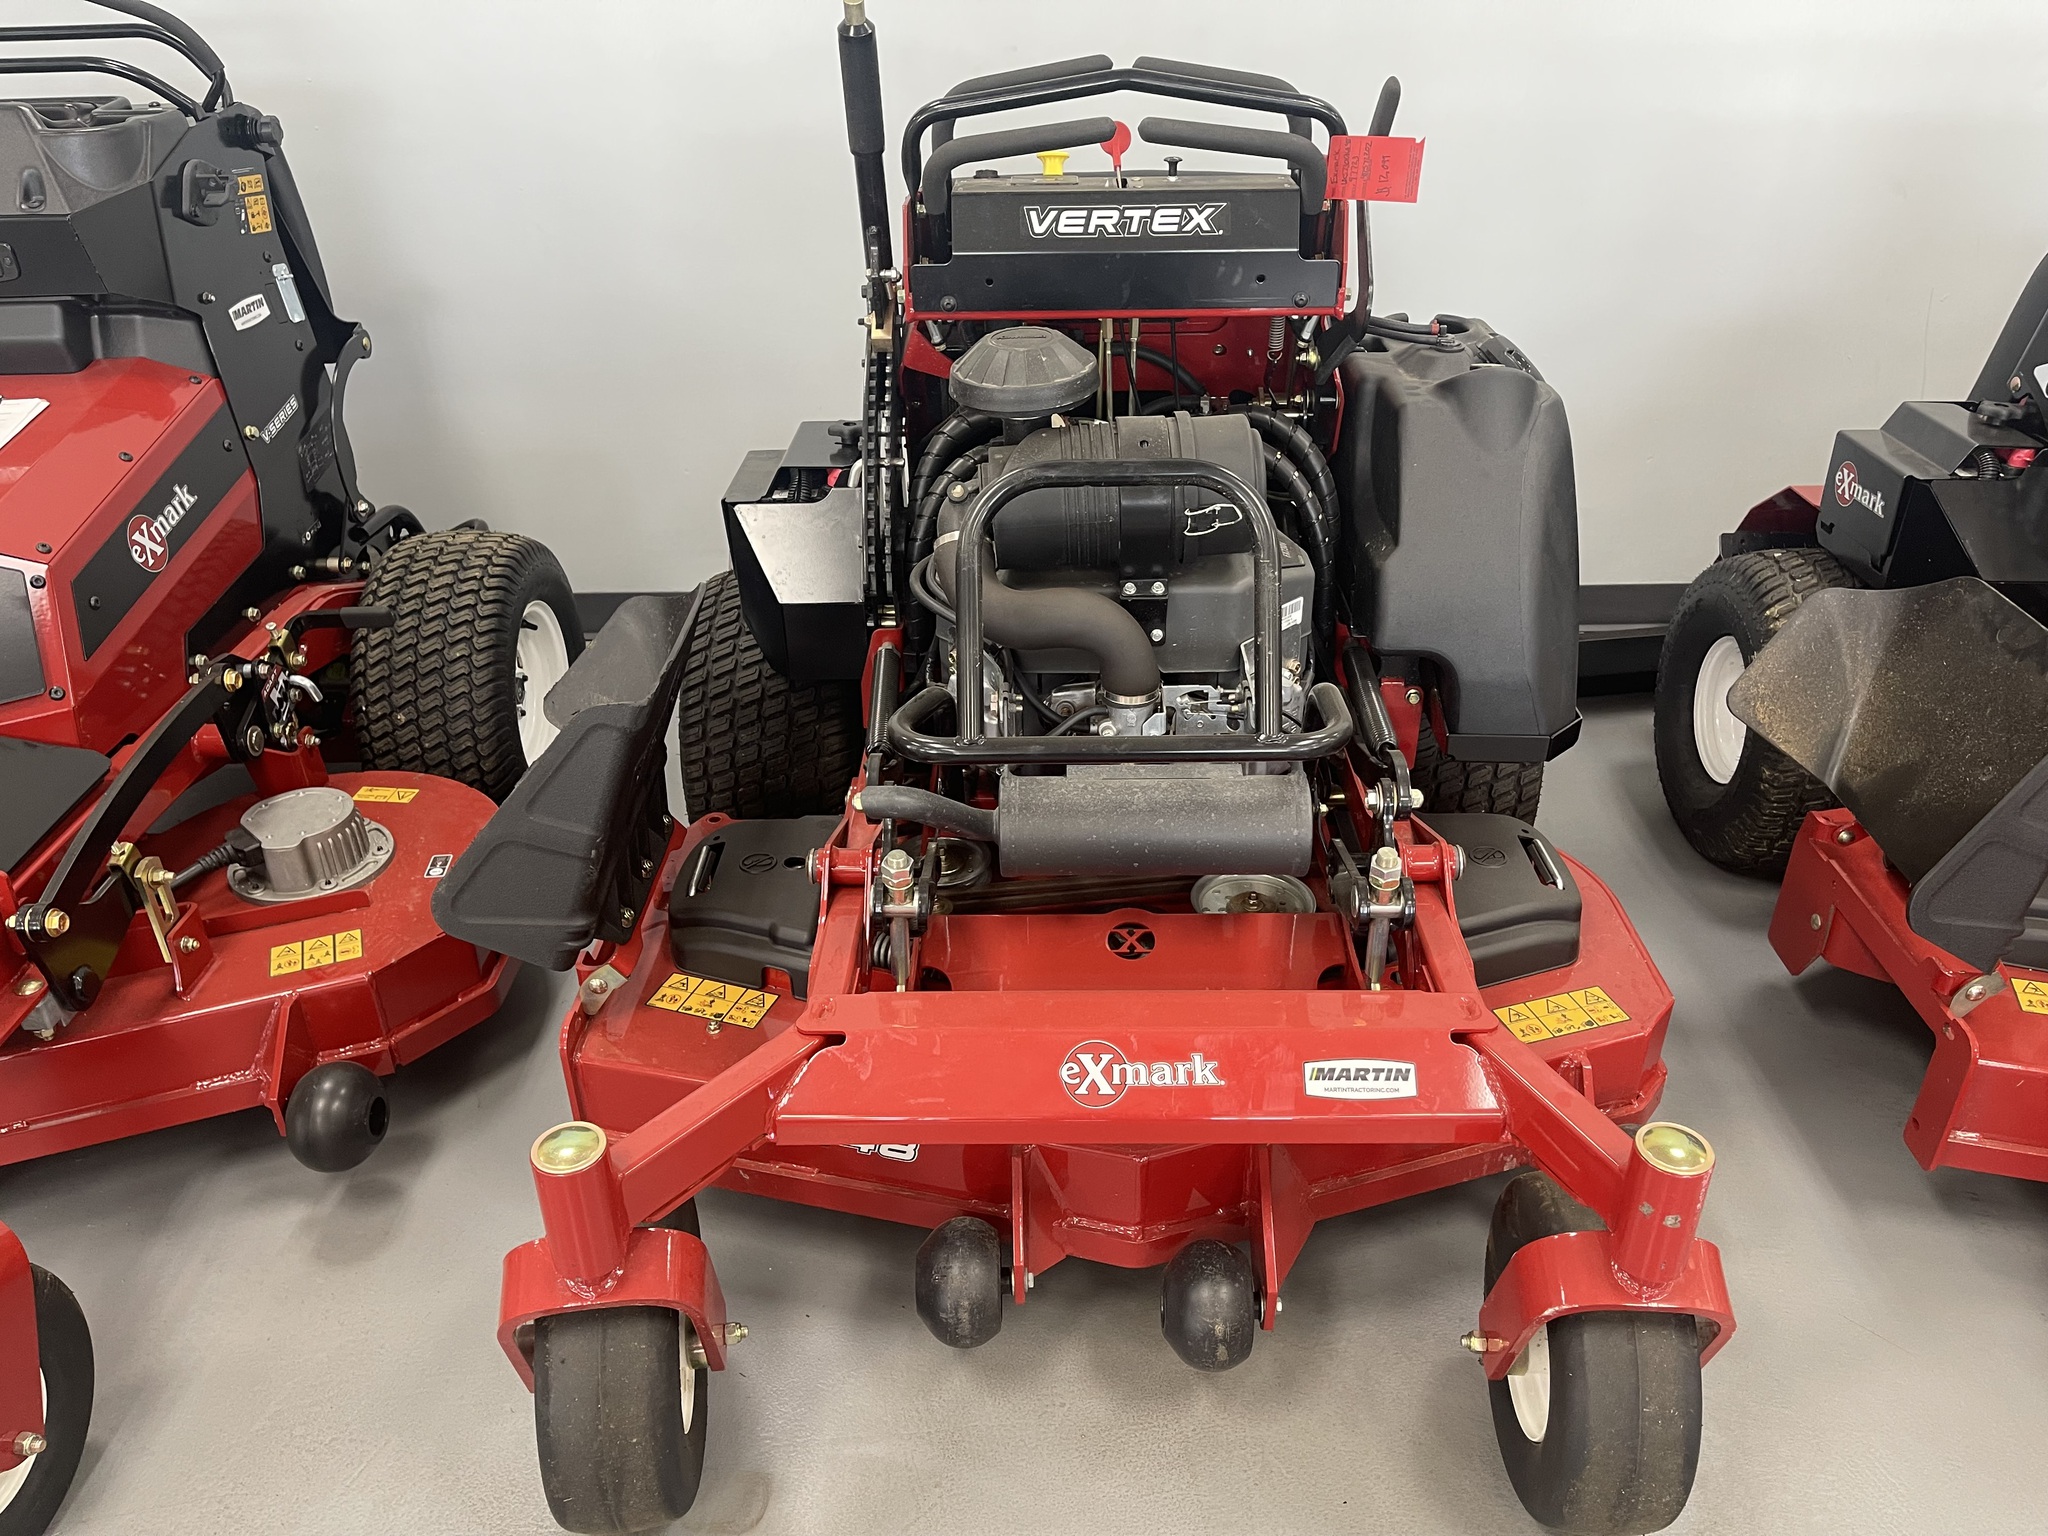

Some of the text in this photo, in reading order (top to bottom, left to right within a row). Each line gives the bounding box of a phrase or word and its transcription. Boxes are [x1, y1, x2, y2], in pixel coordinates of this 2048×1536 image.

[1024, 203, 1227, 238] VERTEX
[232, 297, 265, 321] MARTIN
[1834, 467, 1885, 518] eXmark
[131, 484, 198, 567] eXmark
[1059, 1053, 1226, 1095] eXmark
[1309, 1067, 1411, 1082] MARTIN
[1323, 1086, 1400, 1094] MARTINTRACTORINC.COM
